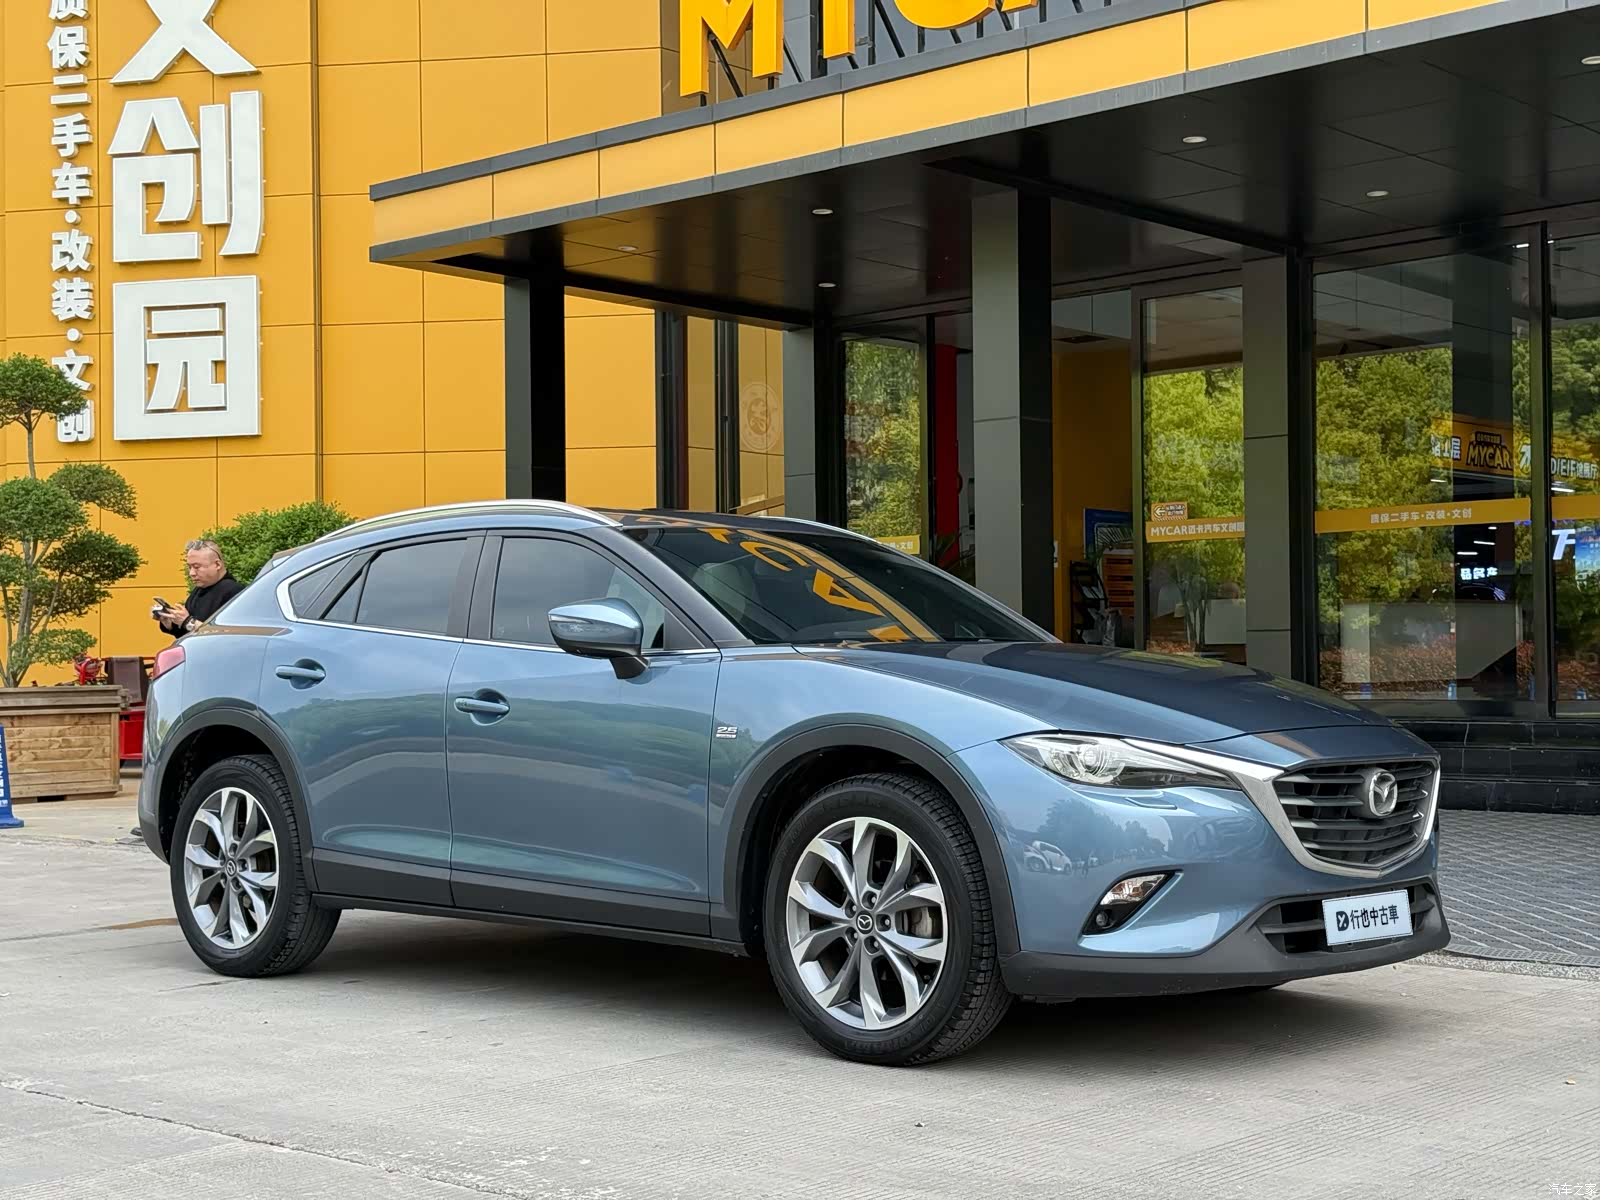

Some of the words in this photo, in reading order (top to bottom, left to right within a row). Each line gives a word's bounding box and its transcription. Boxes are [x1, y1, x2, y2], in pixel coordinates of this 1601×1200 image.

[1468, 443, 1512, 469] MYCAR
[1350, 904, 1399, 930] 行也中古車
